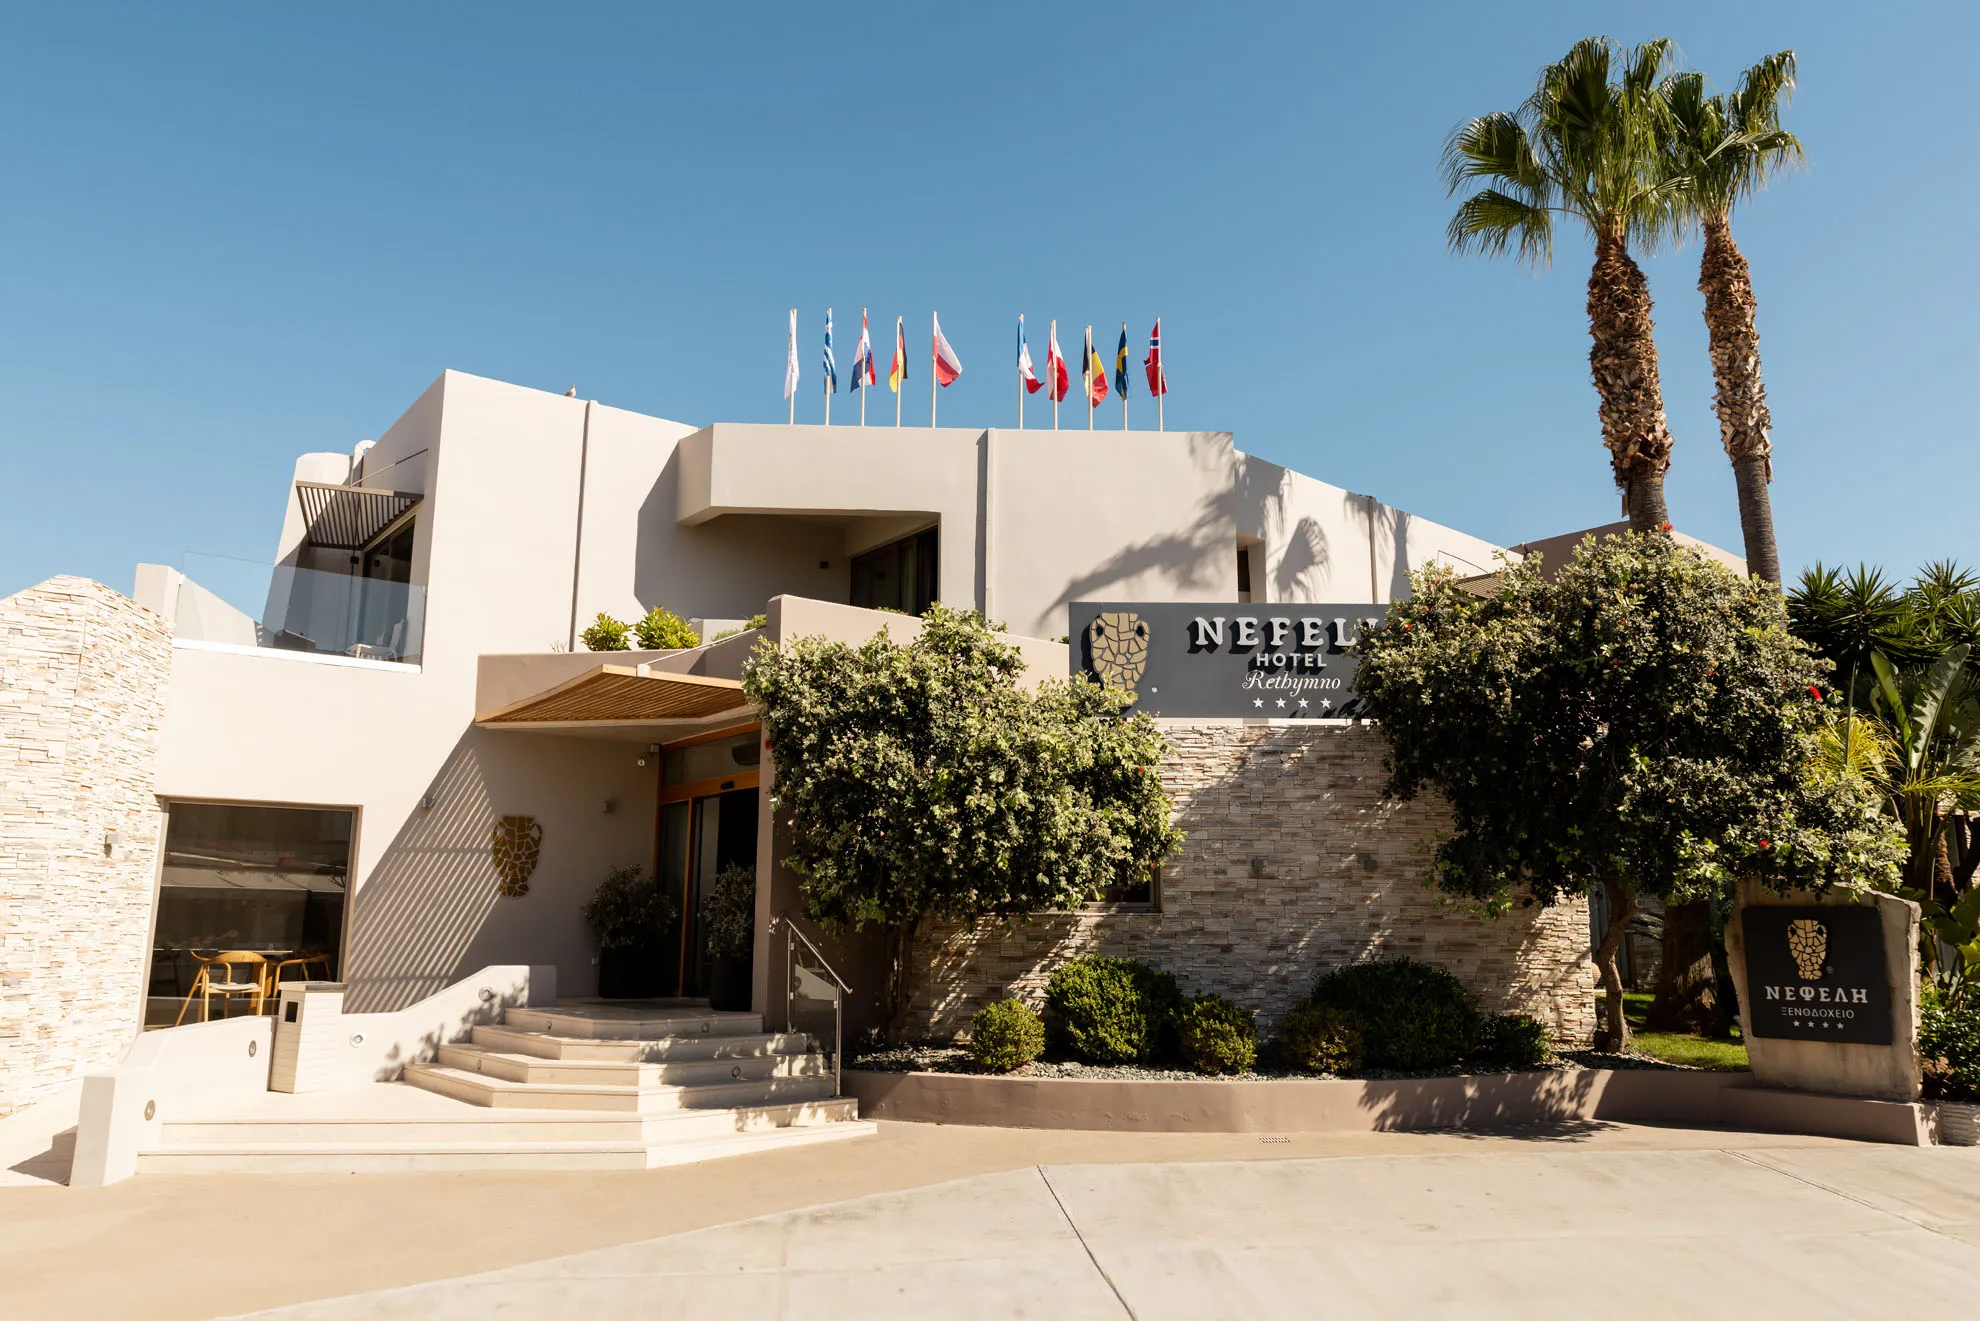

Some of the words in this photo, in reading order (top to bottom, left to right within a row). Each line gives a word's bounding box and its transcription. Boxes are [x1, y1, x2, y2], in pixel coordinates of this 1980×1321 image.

[1256, 653, 1328, 667] HOTEL
[1242, 669, 1341, 697] Rethymno
[1765, 986, 1868, 1003] ΝΕΦΕΛΗ
[1781, 1007, 1855, 1019] ΞΕΝΟΔΟΧΕΙΟ
